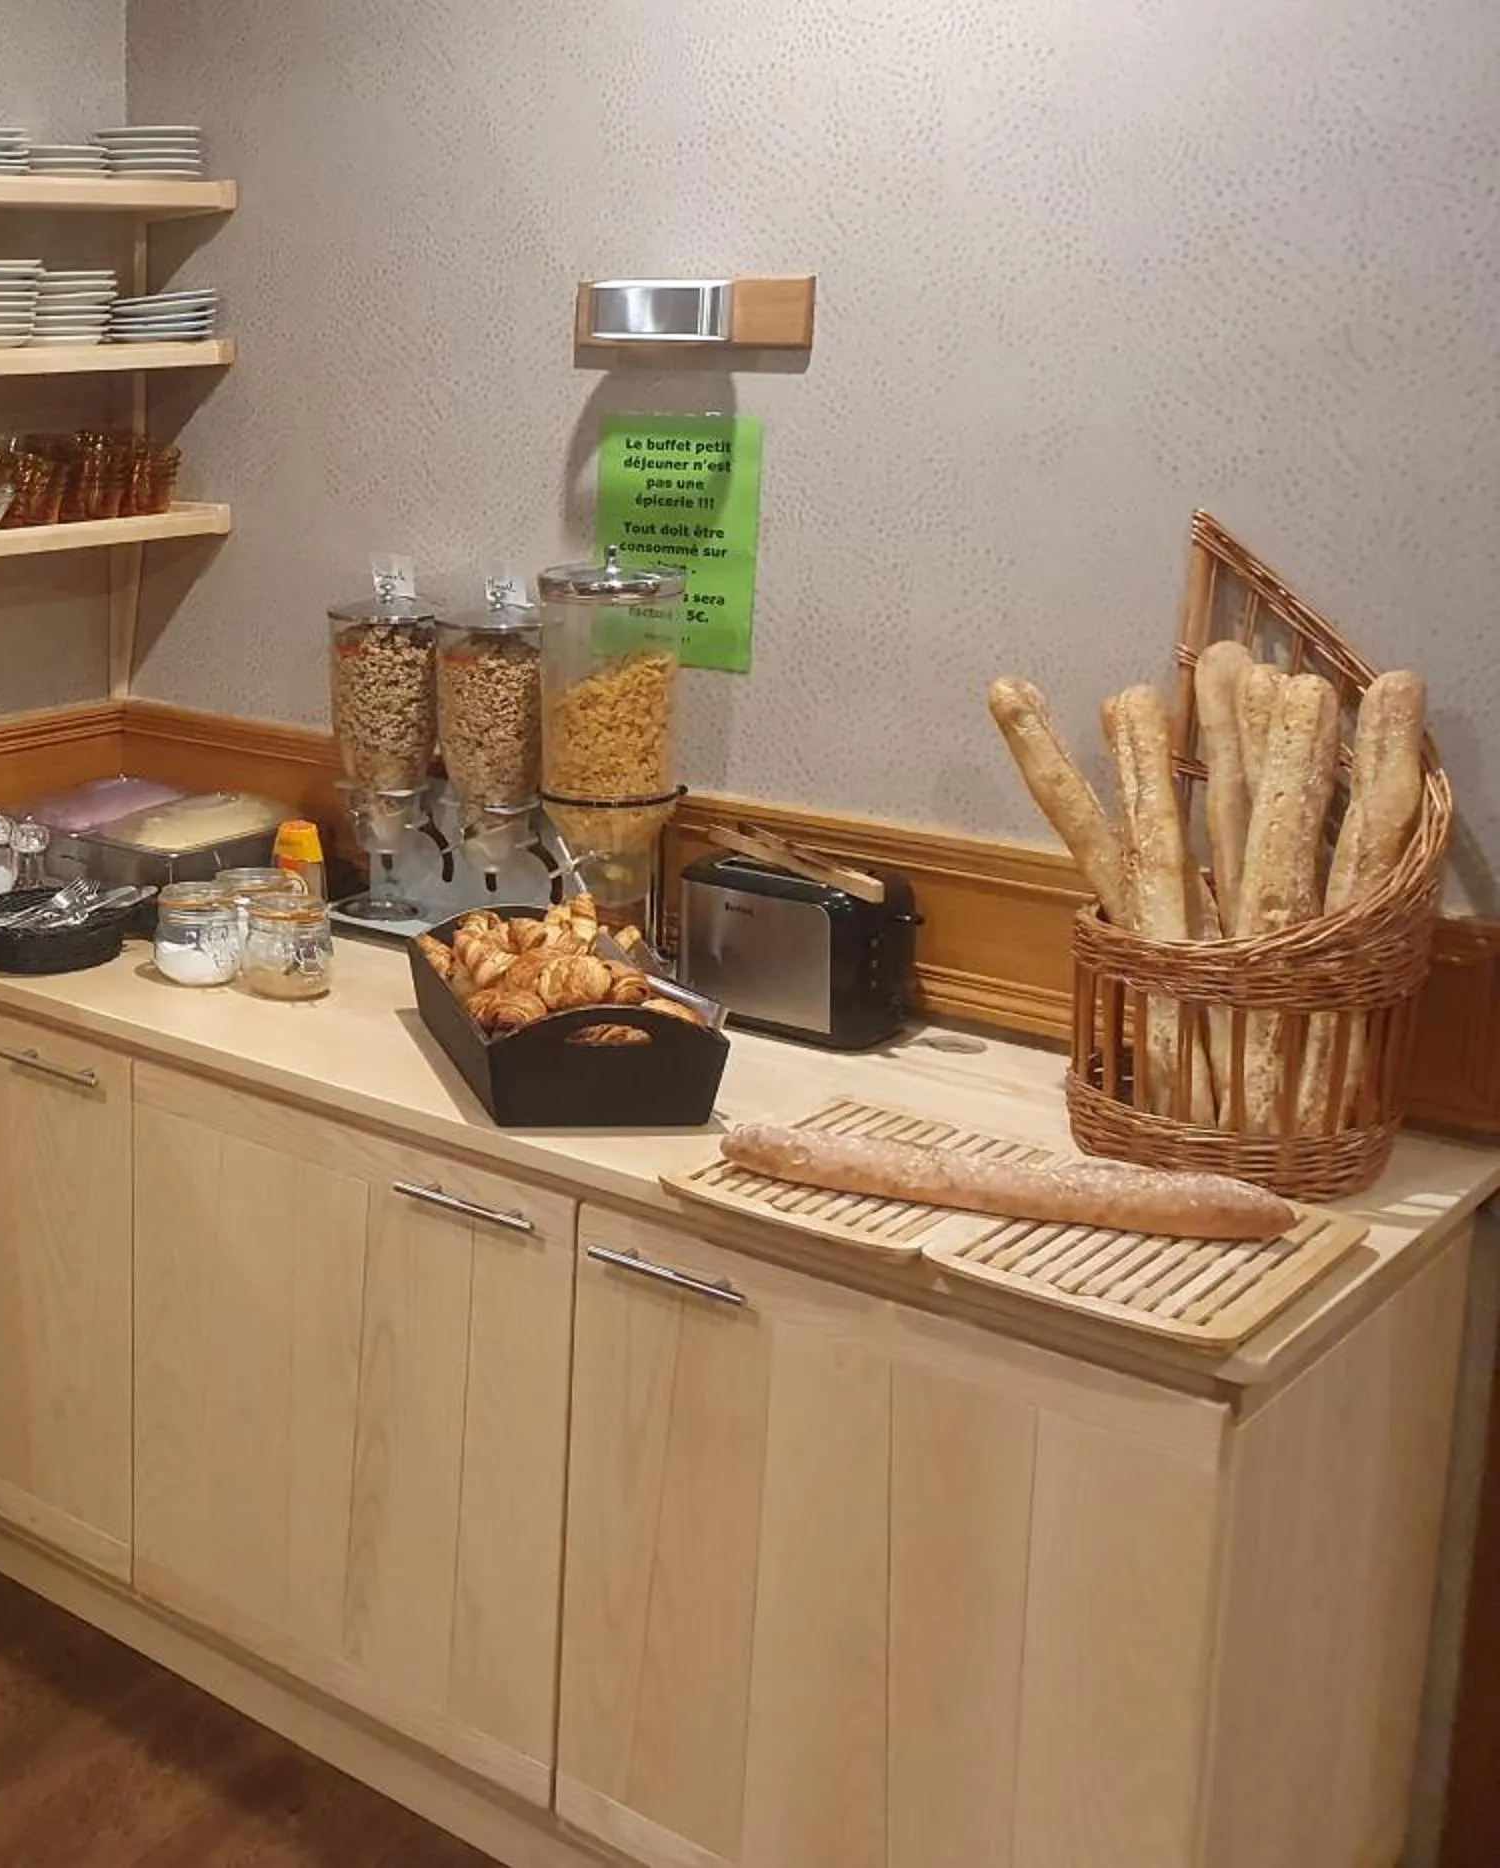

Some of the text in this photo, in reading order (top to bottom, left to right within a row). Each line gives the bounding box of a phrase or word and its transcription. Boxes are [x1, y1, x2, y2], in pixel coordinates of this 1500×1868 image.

[626, 438, 732, 455] Le buffet petit
[624, 456, 689, 471] déjeuner
[646, 479, 704, 490] pas une
[635, 493, 694, 508] épicerie
[624, 521, 725, 539] Tout doit être
[619, 542, 728, 558] consommé sur
[693, 594, 725, 606] sera
